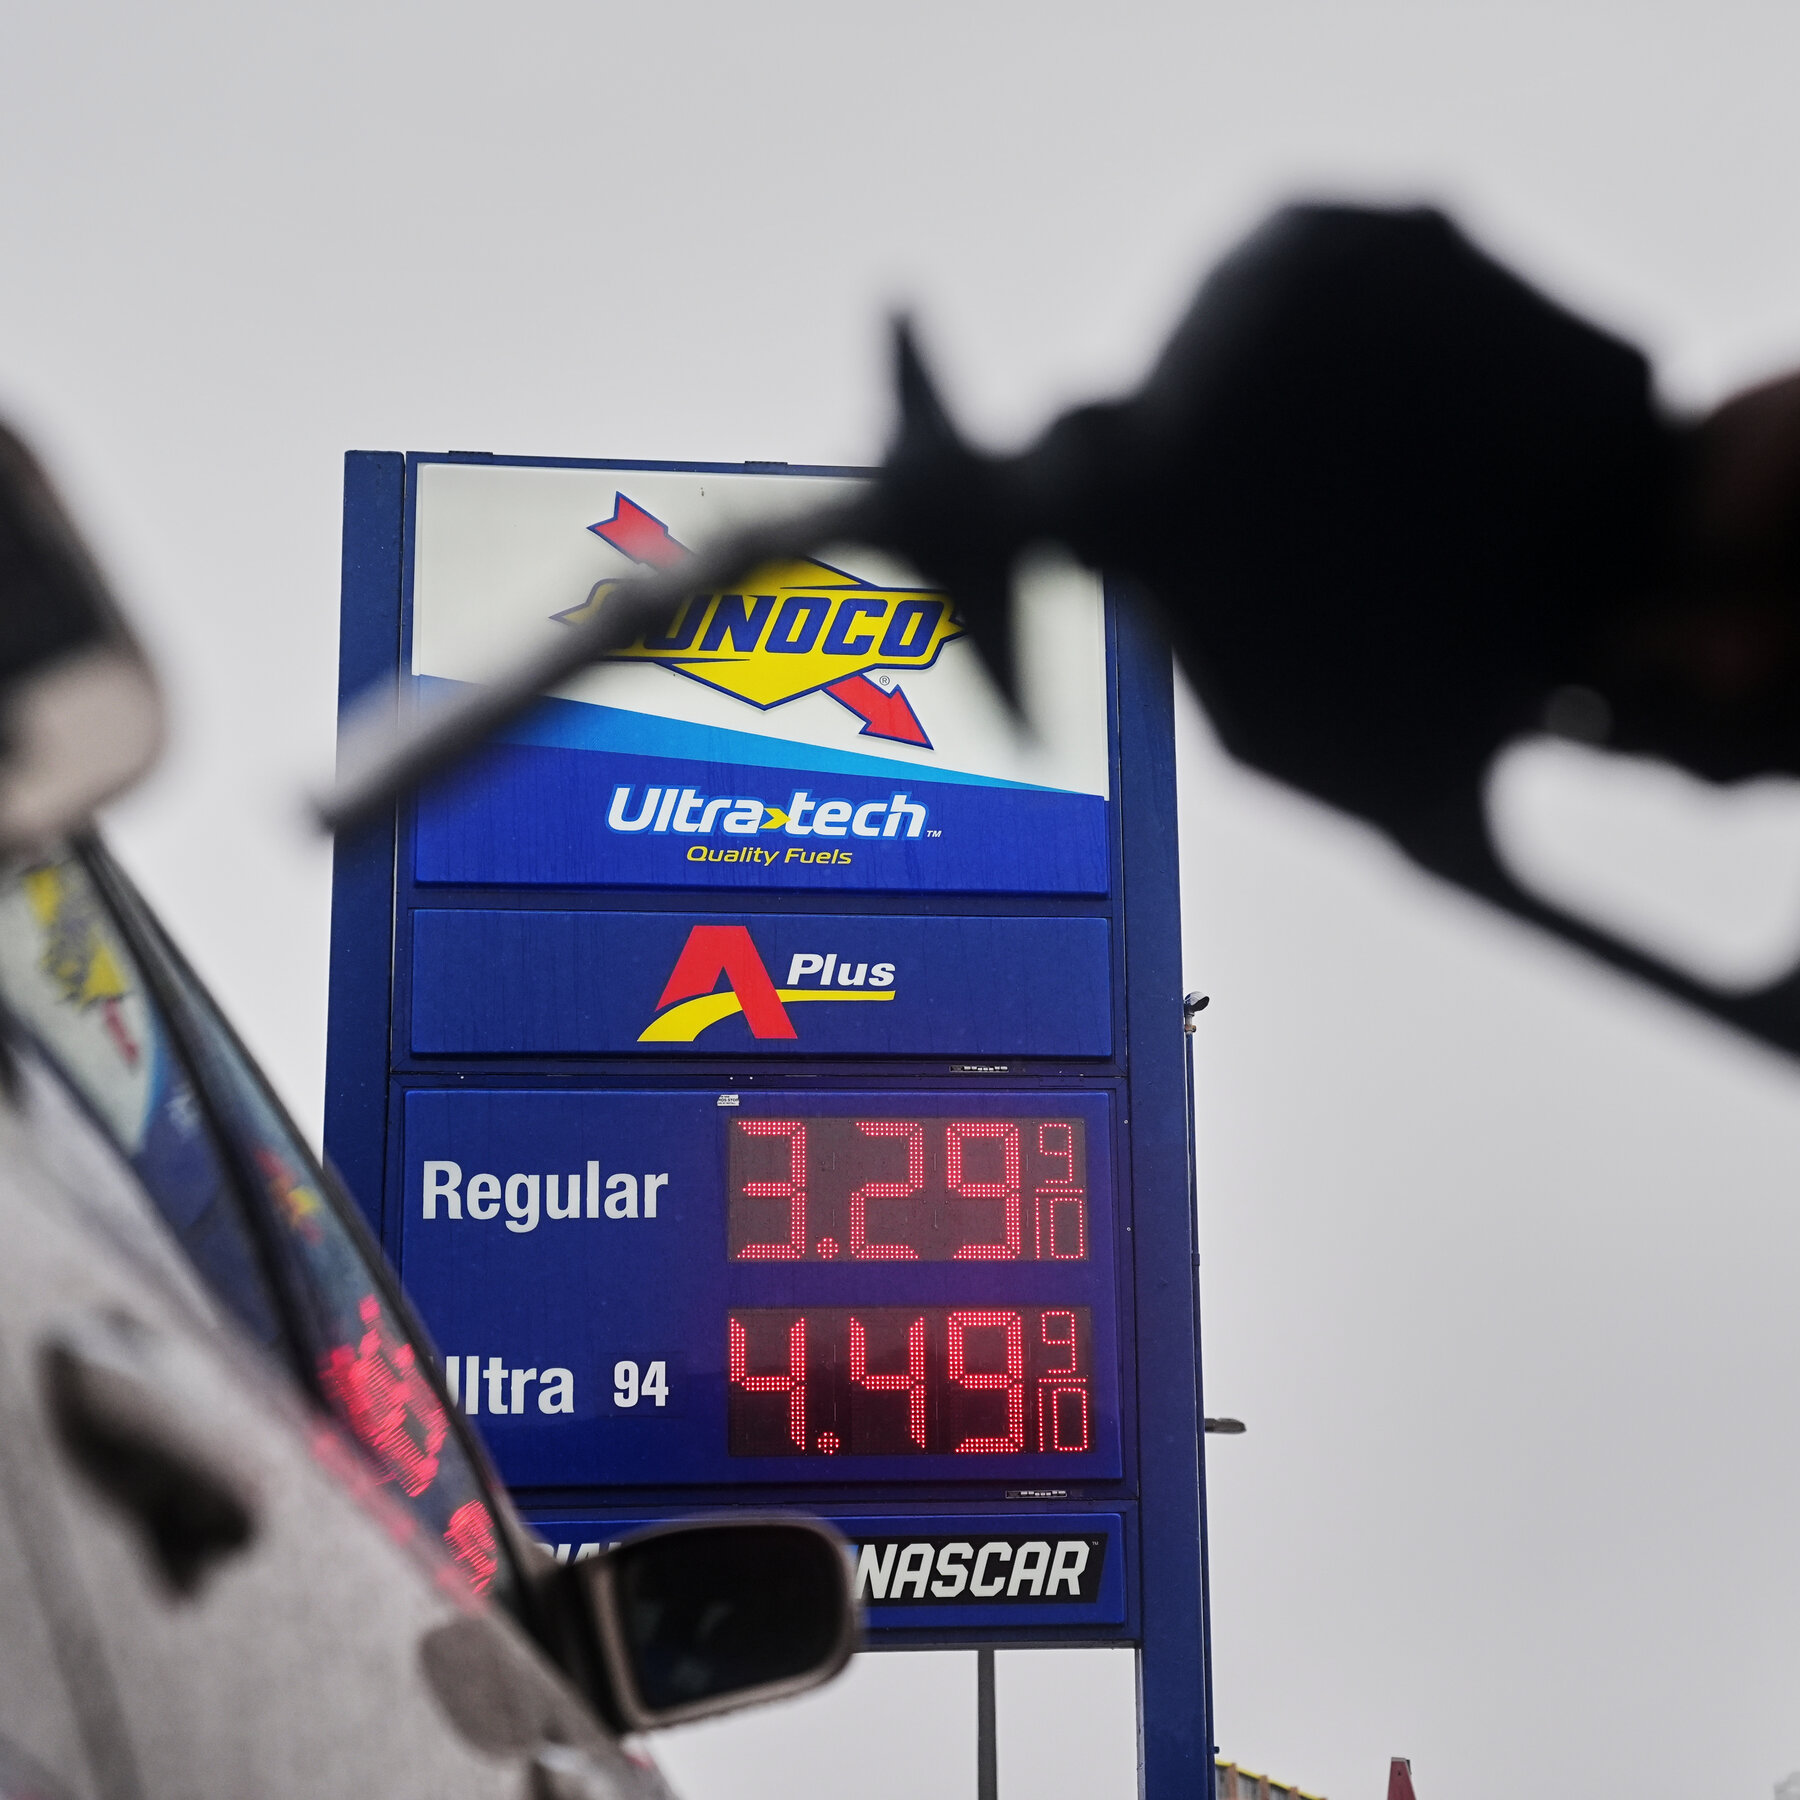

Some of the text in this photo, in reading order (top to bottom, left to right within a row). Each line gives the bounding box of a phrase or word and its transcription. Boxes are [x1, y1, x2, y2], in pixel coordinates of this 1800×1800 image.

[615, 593, 945, 658] UNOCO
[686, 845, 853, 867] Quality Fuels
[786, 953, 896, 987] Plus
[421, 1160, 669, 1233] Regular
[736, 1120, 1022, 1261] 3.29
[613, 1360, 669, 1408] 94
[729, 1310, 1025, 1455] 4.49
[854, 1540, 1090, 1600] NASCAR
